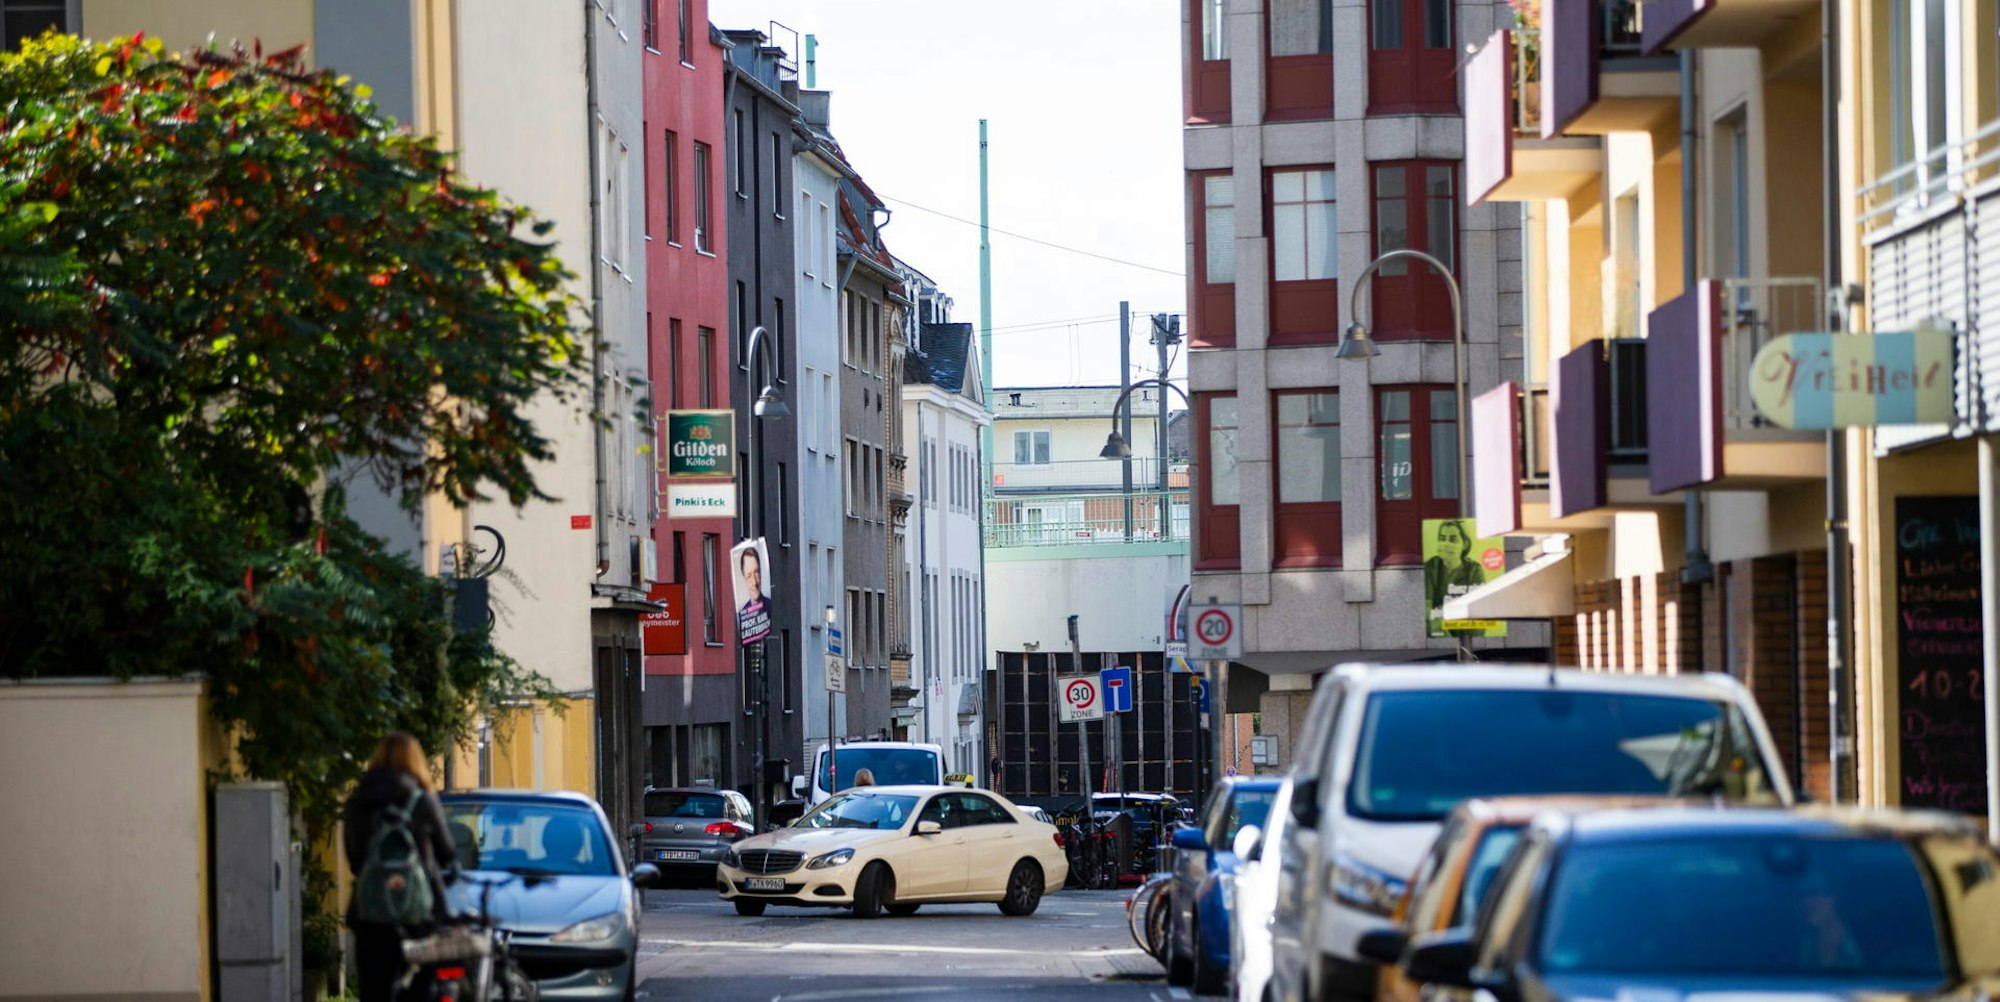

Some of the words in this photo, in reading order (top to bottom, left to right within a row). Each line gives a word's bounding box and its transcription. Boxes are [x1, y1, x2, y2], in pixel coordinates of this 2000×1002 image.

[673, 440, 728, 458] Gilden
[685, 456, 716, 467] Kölsch
[708, 497, 726, 507] Eck
[642, 620, 680, 628] eymeister
[1204, 619, 1226, 637] 20
[1908, 669, 1983, 702] 10-2
[1072, 687, 1090, 701] 30
[1070, 709, 1094, 720] ZONE
